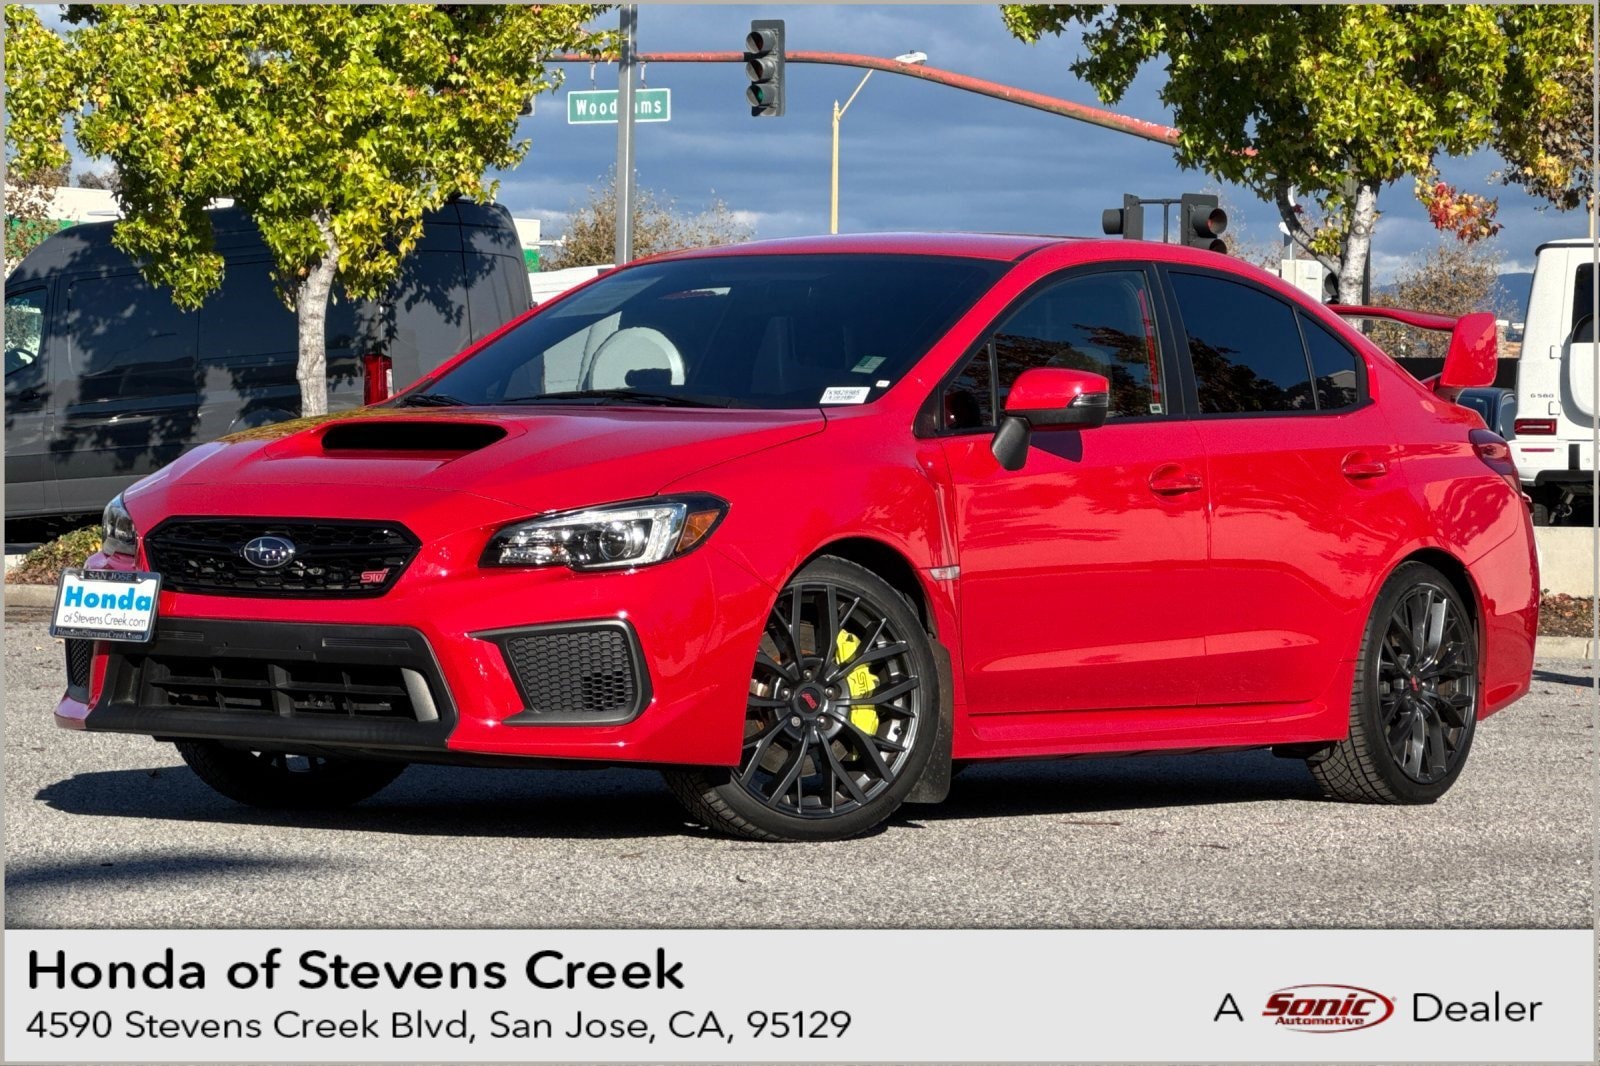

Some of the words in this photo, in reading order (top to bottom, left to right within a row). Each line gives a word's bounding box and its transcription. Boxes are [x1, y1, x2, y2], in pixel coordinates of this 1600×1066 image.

[576, 99, 662, 116] Woodms
[88, 570, 107, 580] SAN
[109, 572, 133, 581] JOSE
[64, 586, 152, 611] Honda
[63, 613, 73, 623] of
[73, 611, 103, 625] Stevens
